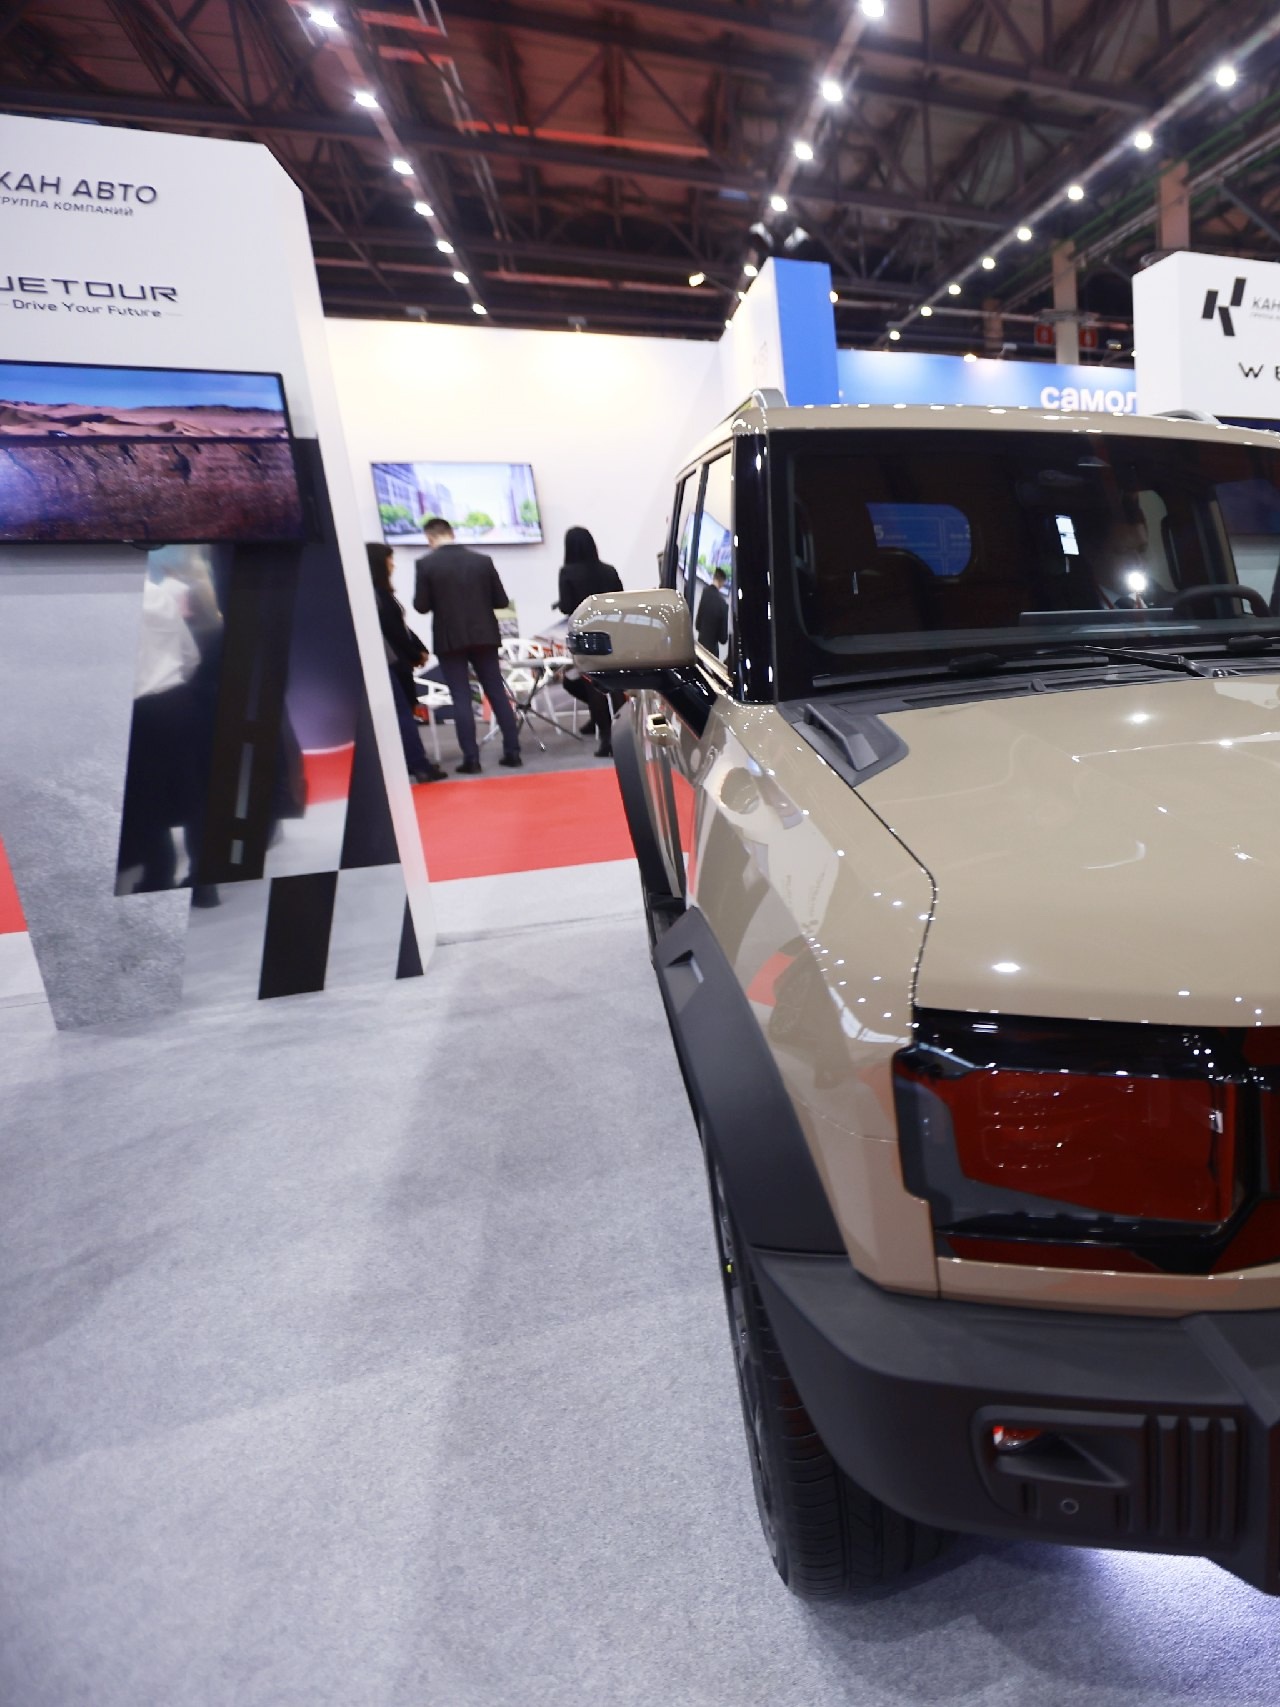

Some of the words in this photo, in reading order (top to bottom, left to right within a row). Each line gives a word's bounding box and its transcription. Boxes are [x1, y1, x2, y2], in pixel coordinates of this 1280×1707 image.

[72, 179, 158, 205] АВТО
[0, 196, 49, 209] РУППА
[53, 201, 134, 217] КОМПАНИЙ
[12, 298, 58, 312] Drive
[62, 302, 103, 314] Your
[108, 304, 162, 317] Future
[1040, 386, 1136, 412] самол
